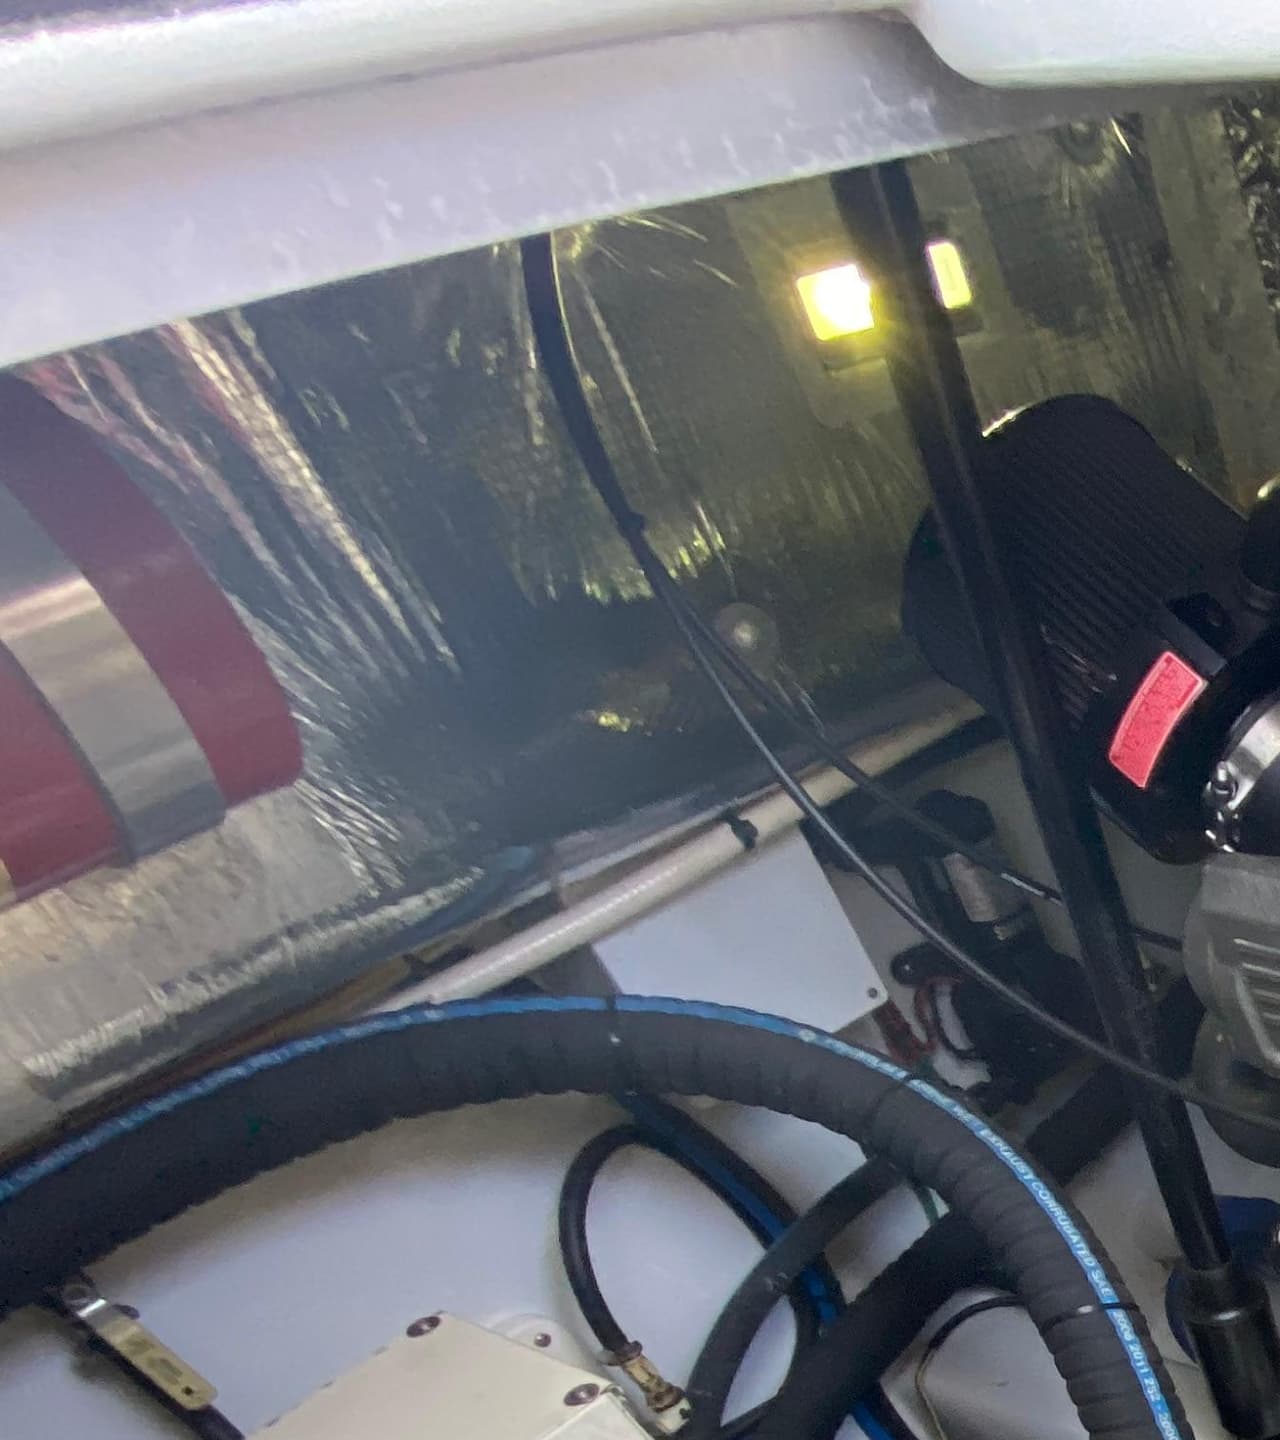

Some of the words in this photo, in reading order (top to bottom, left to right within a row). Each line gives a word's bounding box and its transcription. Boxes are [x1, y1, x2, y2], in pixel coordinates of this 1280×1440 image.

[980, 1128, 1036, 1181] EXHAUST
[1031, 1180, 1097, 1268] CORRUGATED
[1091, 1268, 1114, 1297] SAE
